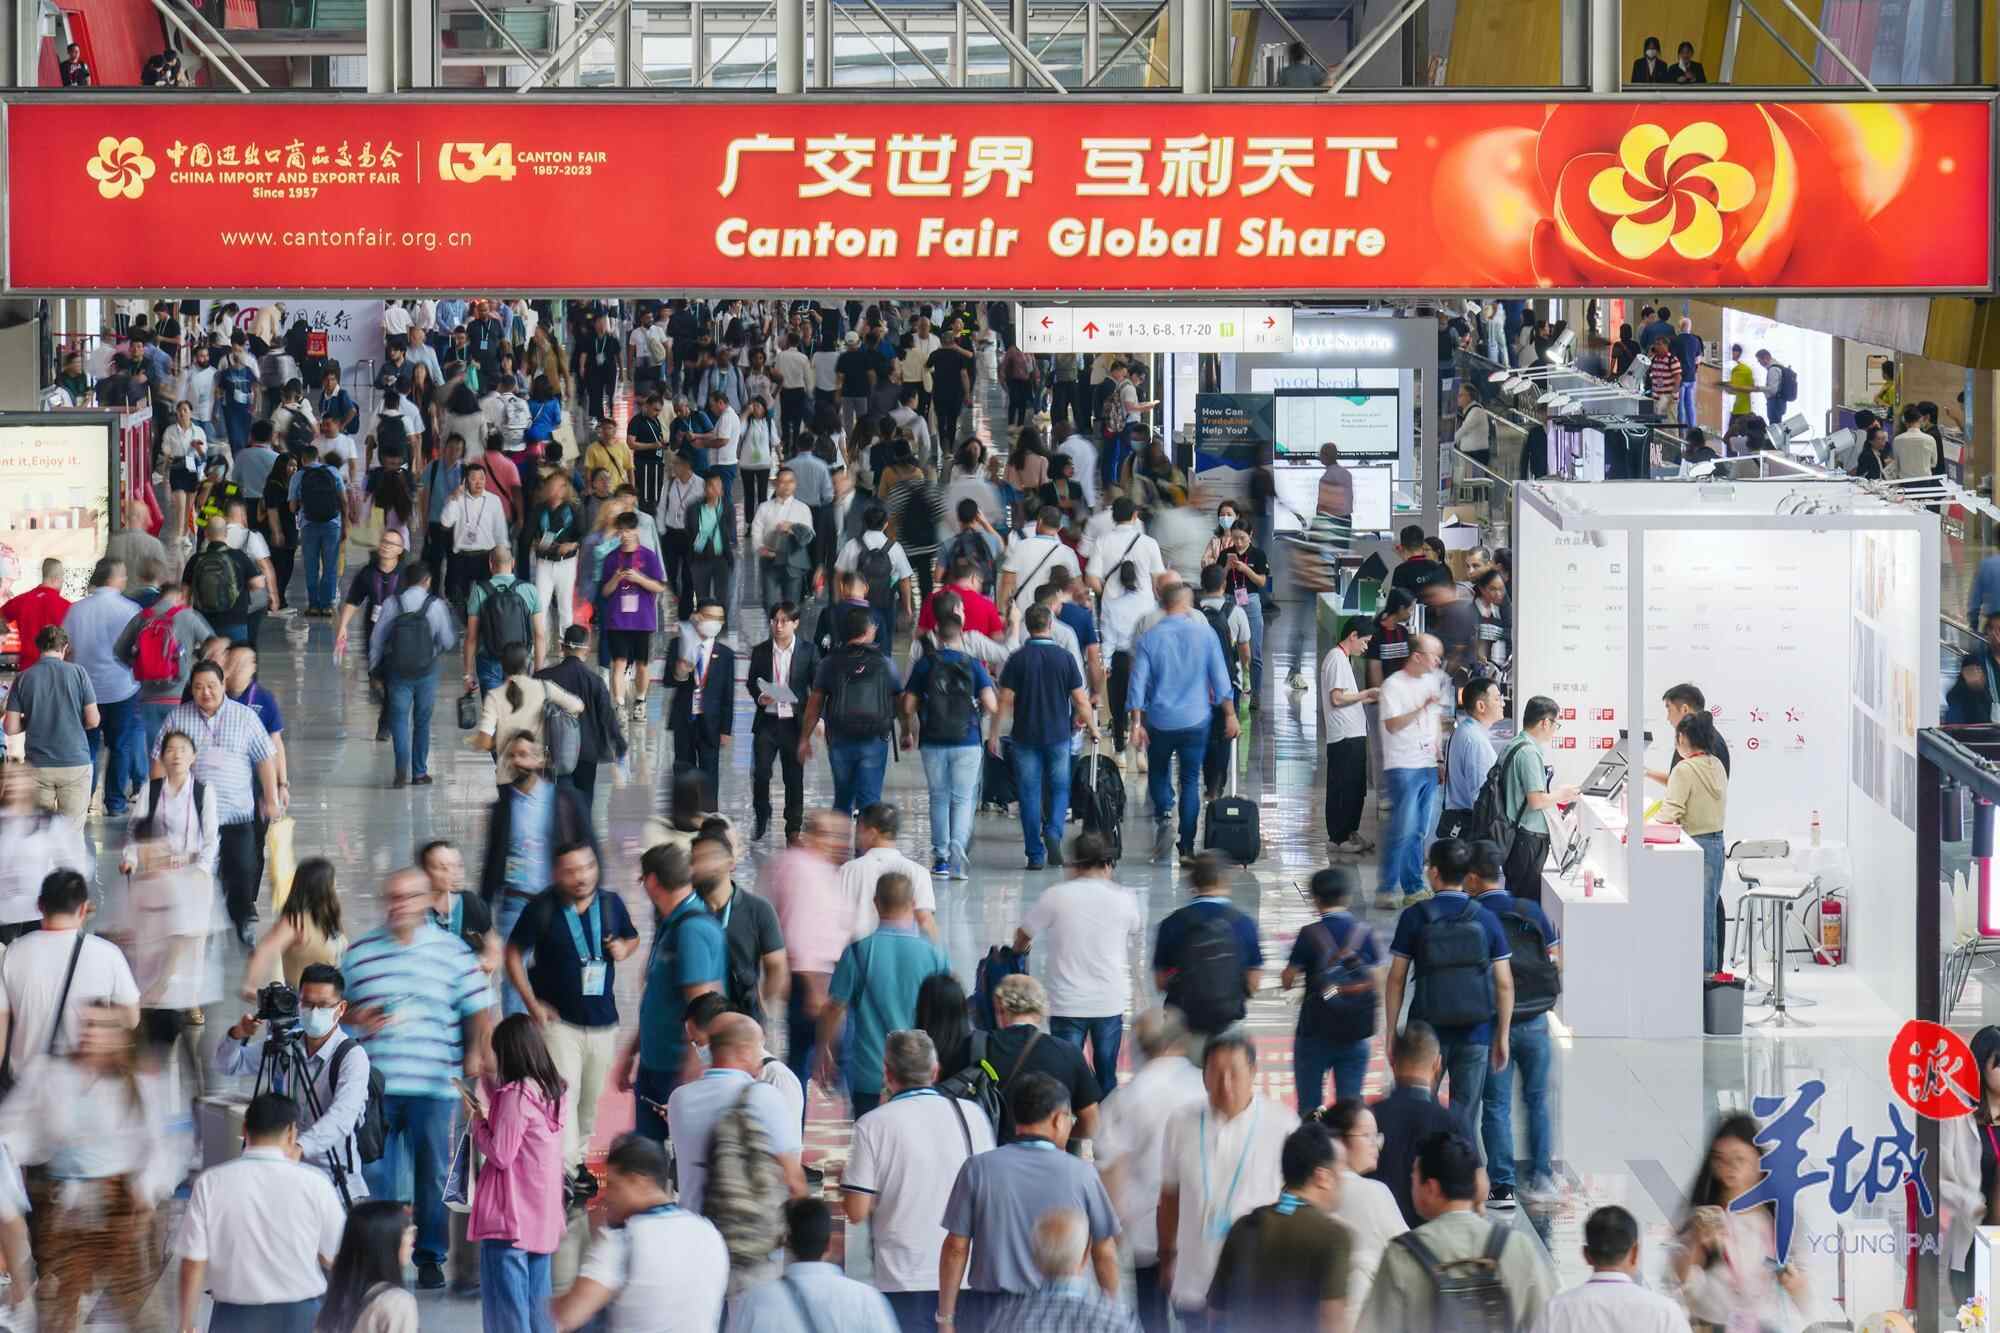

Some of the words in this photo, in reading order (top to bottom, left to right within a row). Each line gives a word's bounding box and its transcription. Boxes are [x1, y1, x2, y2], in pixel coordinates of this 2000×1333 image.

[517, 152, 572, 163] CANTON
[578, 152, 607, 163] FAIR
[717, 133, 1033, 197] 广交世界
[1076, 133, 1398, 197] 互利天下
[170, 172, 214, 183] CHINA
[219, 172, 273, 183] IMPORT
[277, 172, 308, 183] AND
[313, 172, 365, 183] EXPORT
[369, 172, 400, 183] FAIR
[253, 187, 284, 198] Since
[289, 187, 318, 198] 1957
[221, 228, 472, 251] www.cantonfair.org.cn
[715, 217, 898, 257] Canton
[916, 217, 1019, 257] Fair
[1048, 217, 1222, 257] Global
[1236, 217, 1386, 257] Share
[1180, 324, 1212, 336] 17-20
[1202, 408, 1223, 416] How
[1225, 408, 1244, 416] Can
[1202, 427, 1223, 436] Help
[1225, 427, 1248, 435] You?
